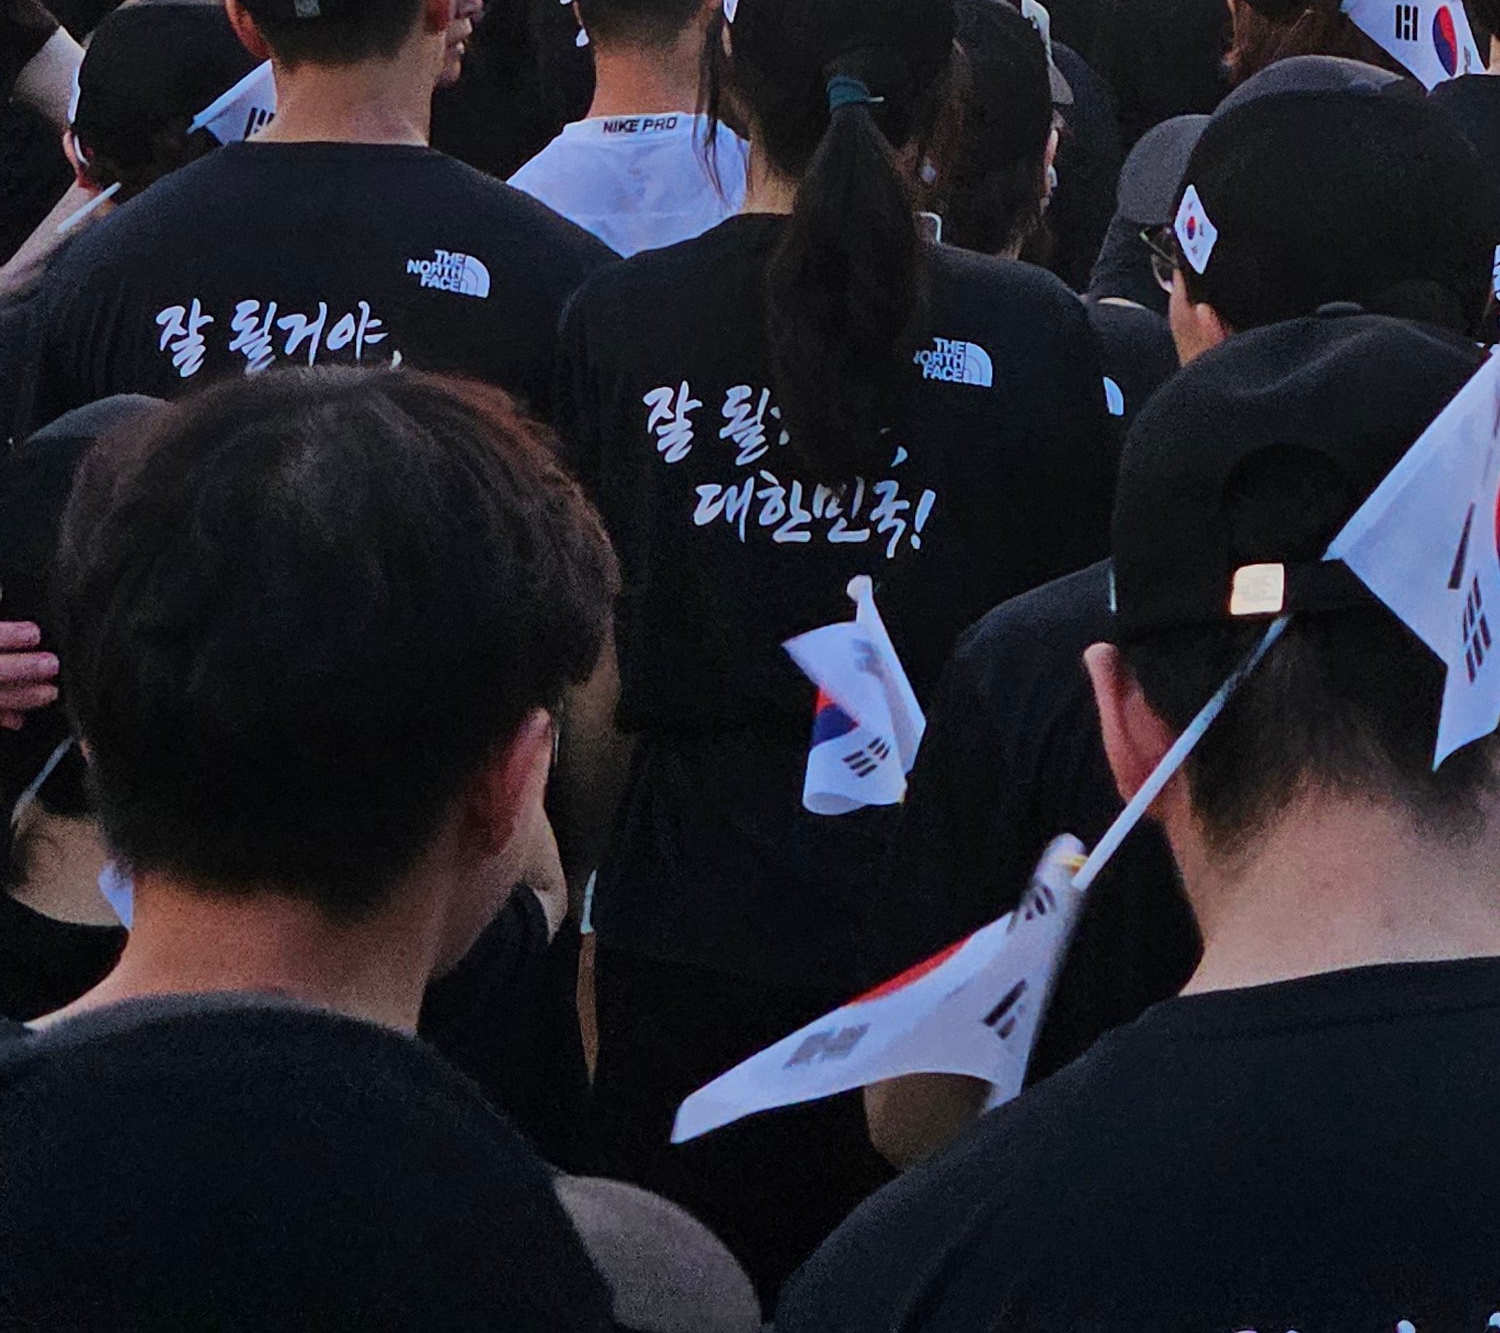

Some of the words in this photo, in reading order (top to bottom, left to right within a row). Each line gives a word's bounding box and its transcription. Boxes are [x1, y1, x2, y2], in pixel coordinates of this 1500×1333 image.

[603, 119, 640, 133] NIKE
[642, 116, 678, 132] PRO
[434, 249, 464, 265] THE
[406, 259, 462, 279] NORTH
[420, 274, 461, 293] FACE
[155, 298, 214, 378] 잘
[228, 299, 403, 376] 될거야,
[933, 337, 966, 354] THE
[922, 366, 964, 383] FACE
[643, 380, 703, 463] 잘
[693, 470, 936, 559] 대한민국!
